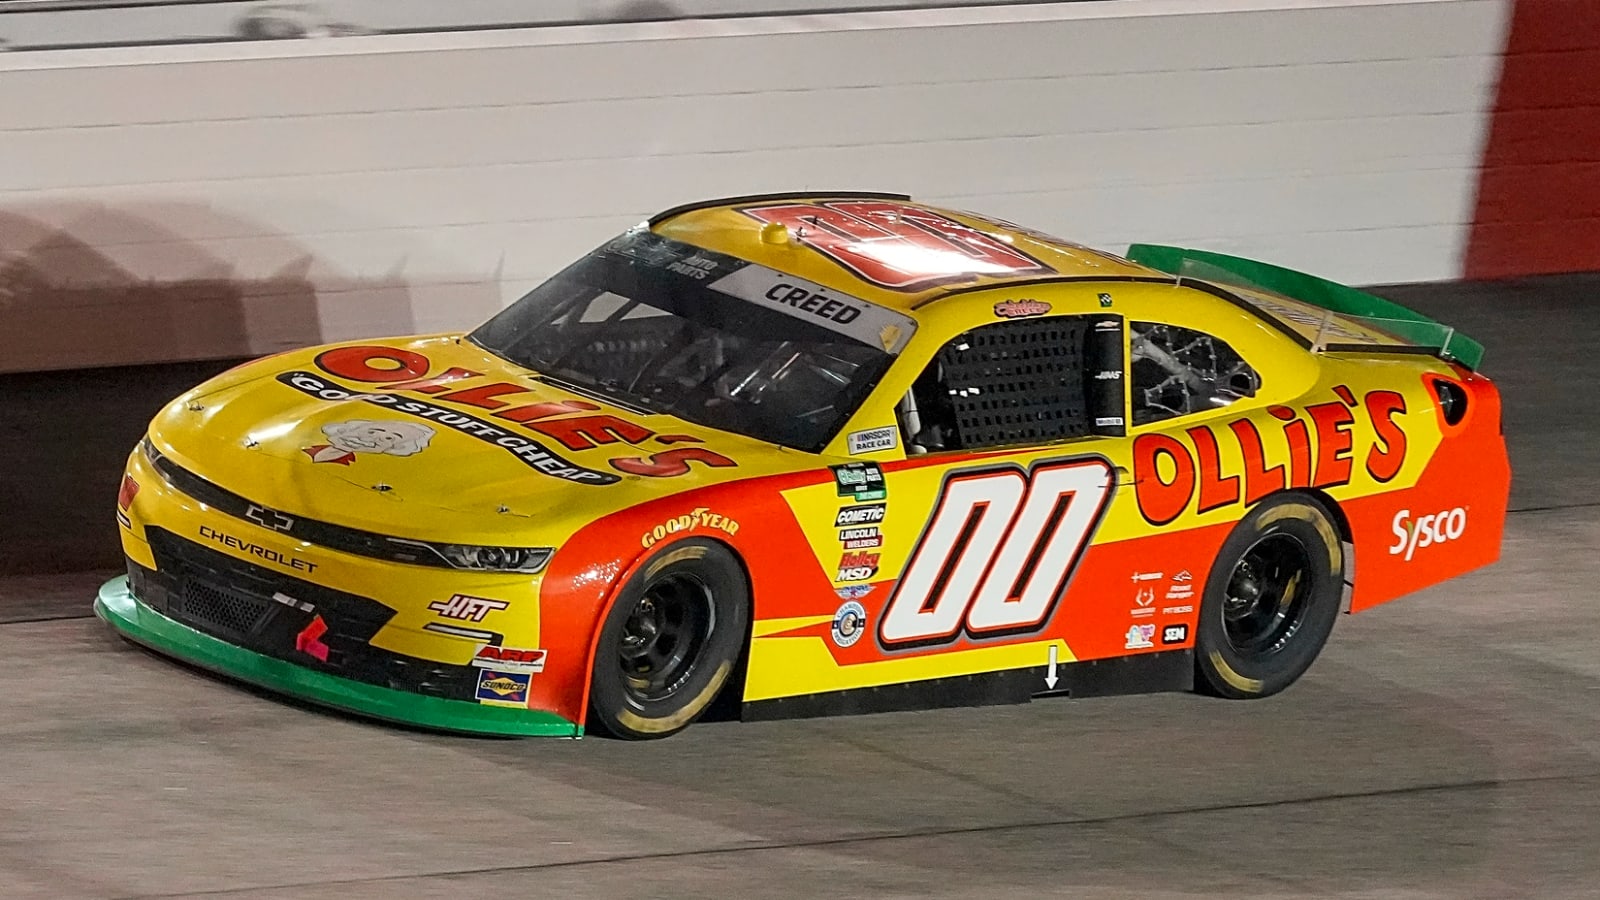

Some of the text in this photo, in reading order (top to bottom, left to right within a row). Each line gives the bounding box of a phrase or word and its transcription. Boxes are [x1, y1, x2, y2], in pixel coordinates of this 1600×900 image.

[765, 283, 861, 324] CREED
[396, 402, 505, 436] STUFF
[859, 430, 891, 442] NASCAR
[856, 439, 891, 450] RACE CAR
[837, 508, 885, 523] COMETIC
[841, 528, 877, 540] LINCOLN
[200, 526, 318, 573] CHEVROLET
[846, 538, 879, 548] WELDERS
[878, 458, 1117, 651] 00
[836, 566, 874, 582] MSD
[476, 646, 544, 663] ARP
[482, 680, 525, 691] SUNOCO
